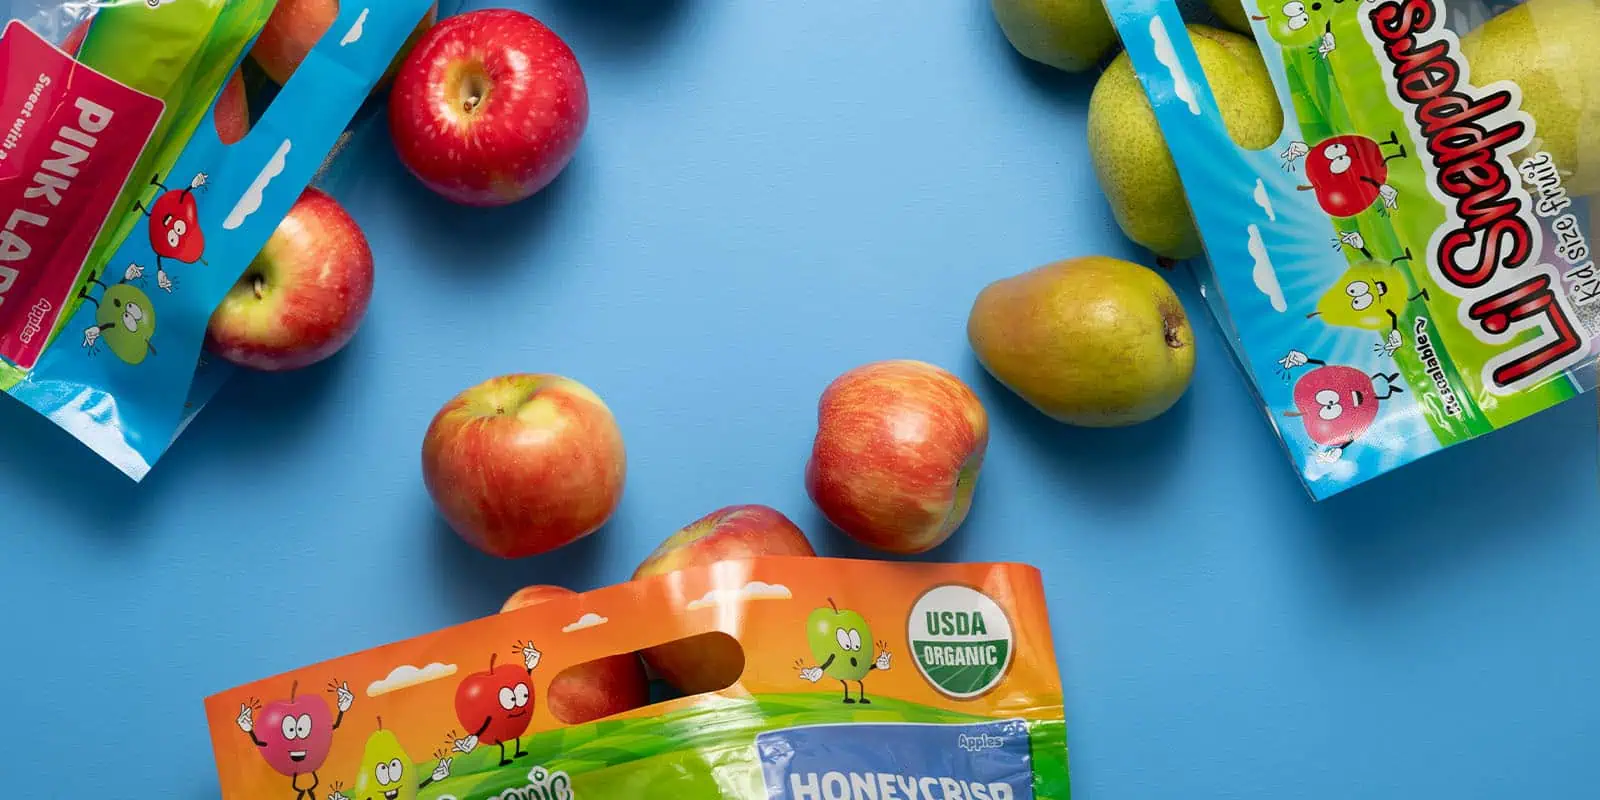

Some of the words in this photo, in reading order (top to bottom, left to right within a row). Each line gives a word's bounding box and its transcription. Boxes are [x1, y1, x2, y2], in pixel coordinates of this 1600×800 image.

[20, 73, 51, 117] Sweet
[3, 118, 26, 150] with
[24, 97, 115, 207] PINK
[1368, 0, 1534, 288] Snappers
[1522, 154, 1569, 213] fruit
[0, 208, 50, 305] LAD
[1556, 216, 1586, 261] size
[20, 297, 52, 344] Apples
[926, 611, 987, 636] USDA
[923, 644, 998, 666] ORGANIC
[958, 733, 1004, 752] Apples
[789, 771, 1014, 800] HONEYCRISP
